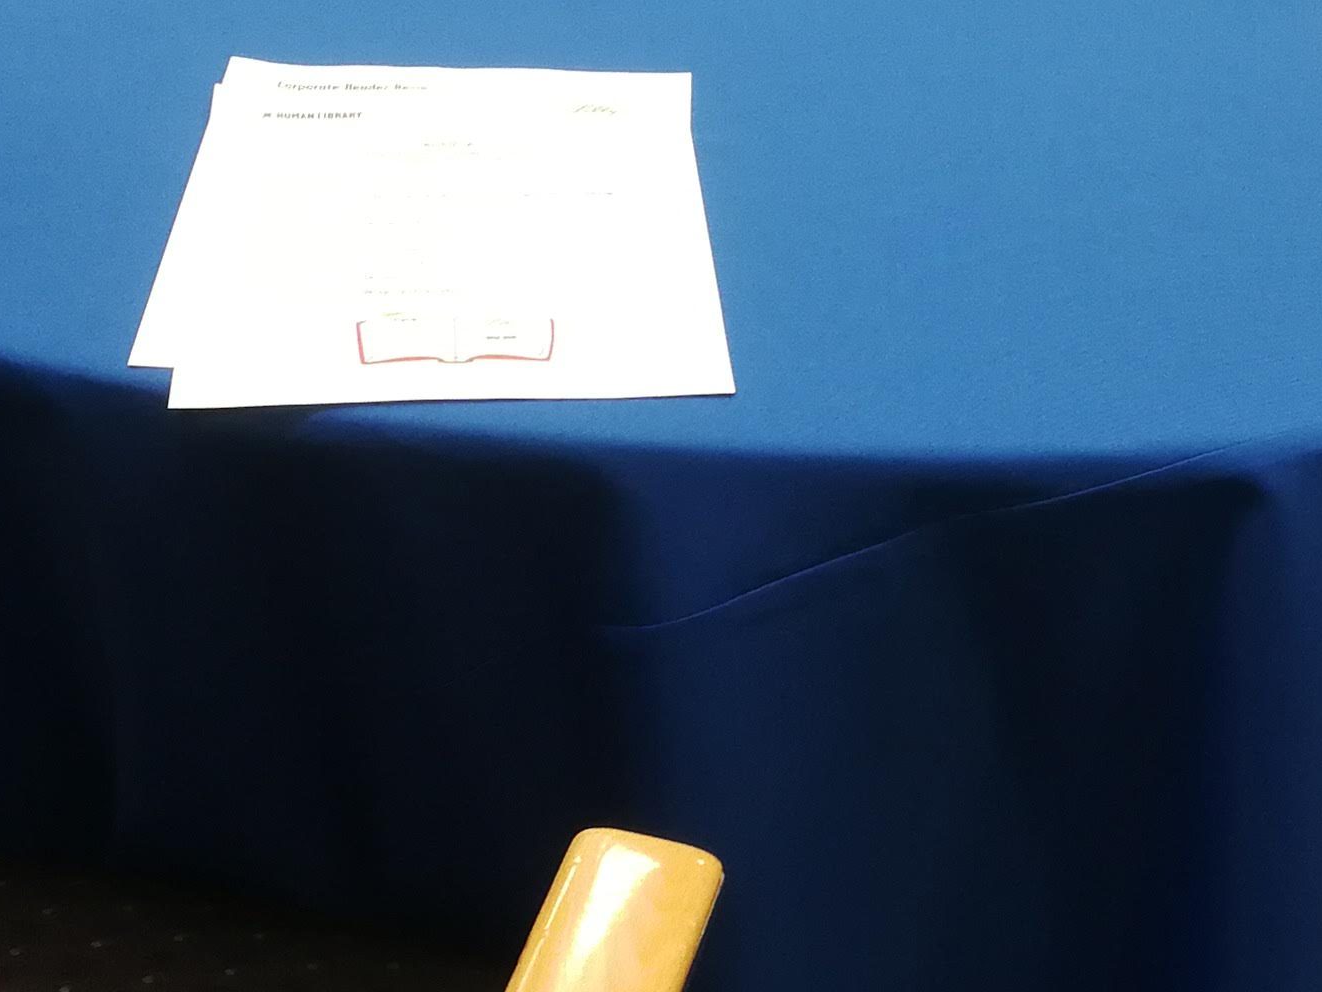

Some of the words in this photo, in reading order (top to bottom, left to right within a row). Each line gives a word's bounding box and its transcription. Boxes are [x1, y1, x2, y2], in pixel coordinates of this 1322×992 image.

[277, 81, 340, 91] Corporate
[276, 111, 314, 120] HUMAN
[317, 111, 363, 120] LIBRARY
